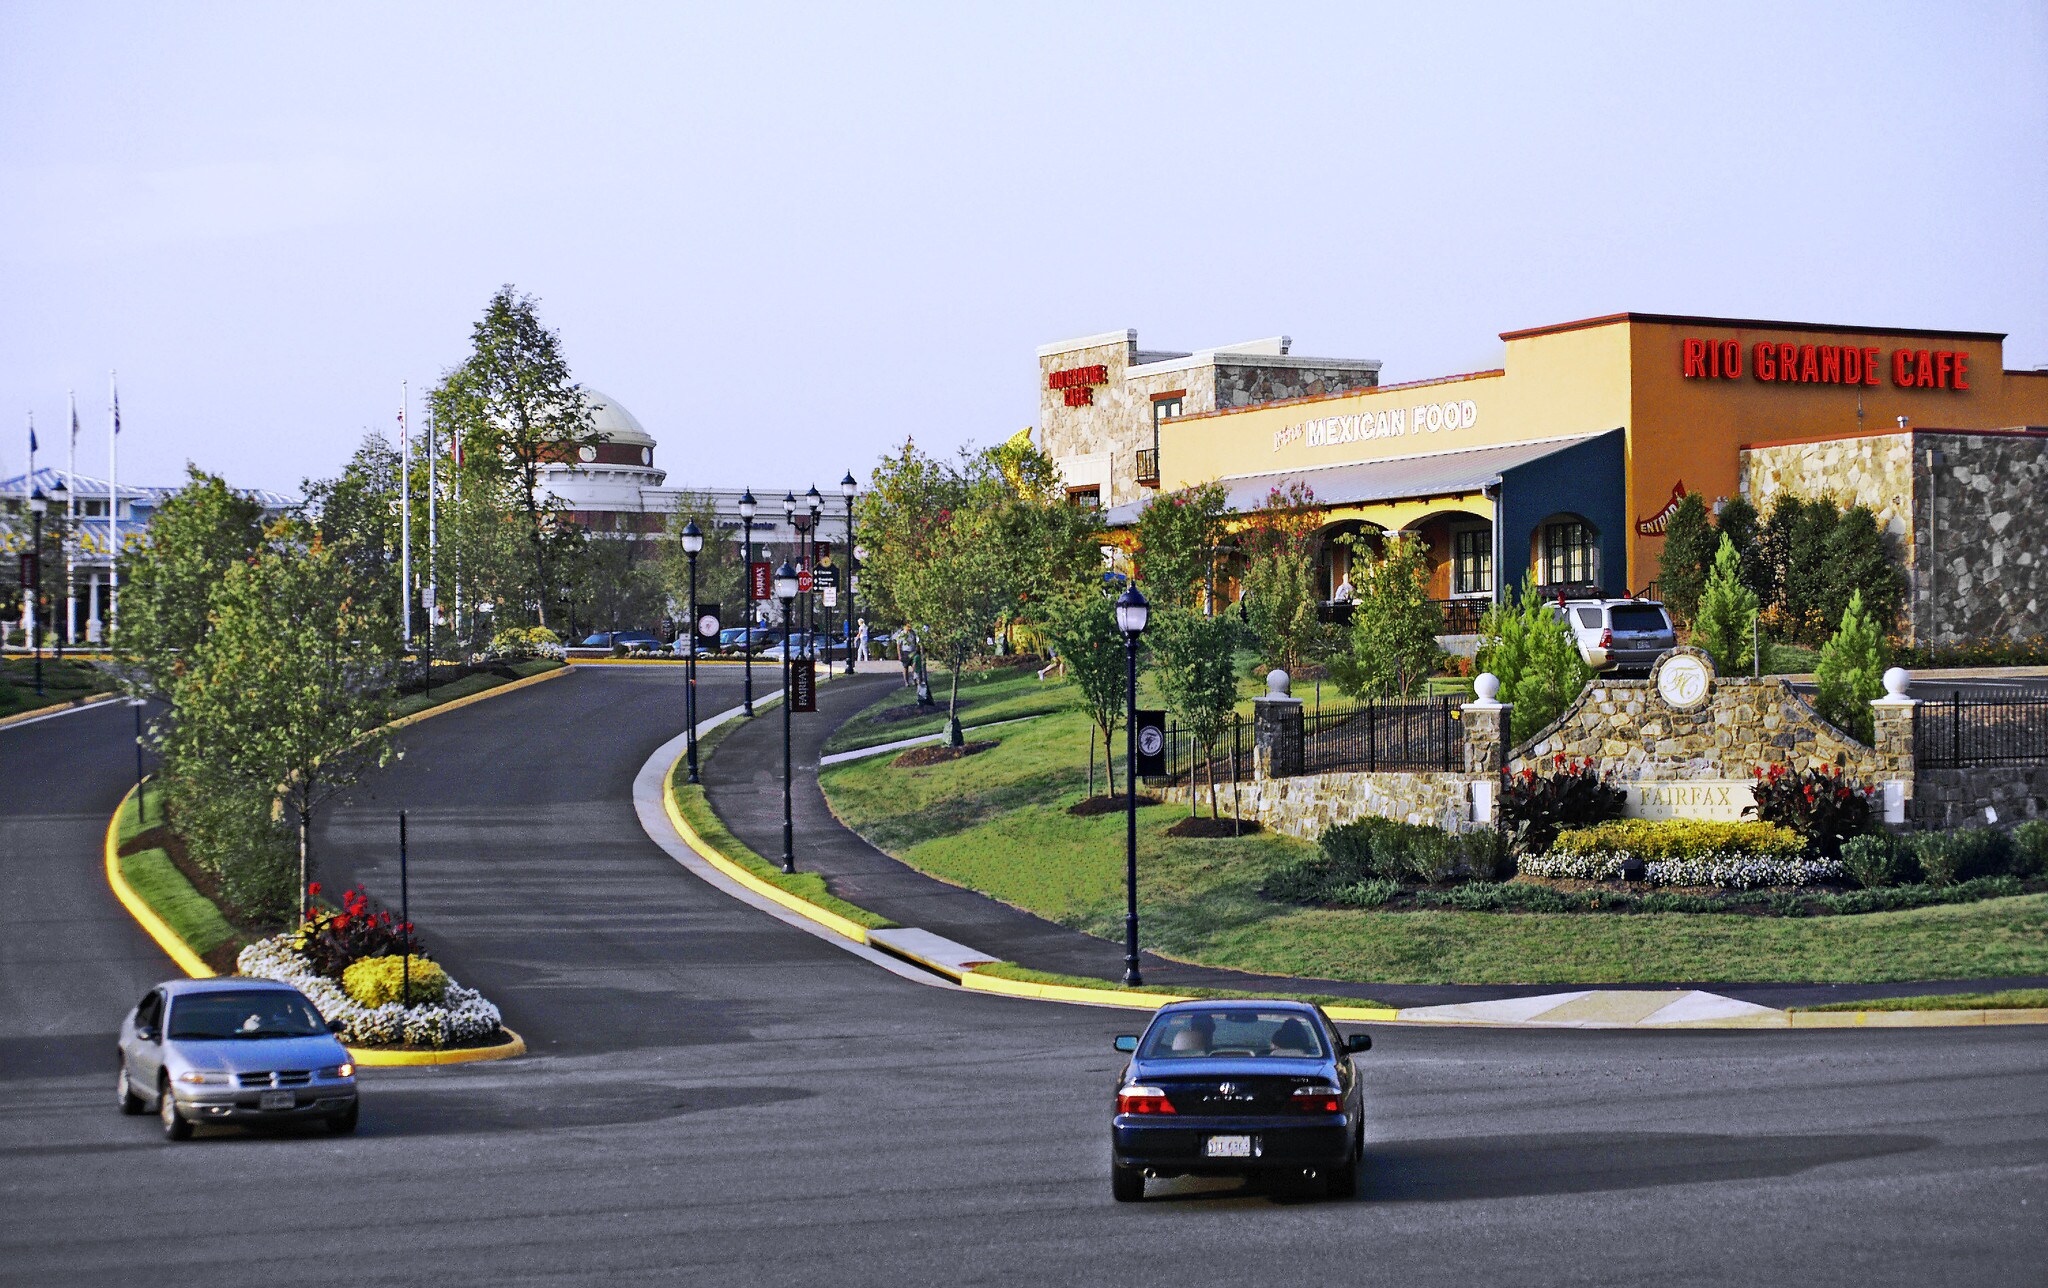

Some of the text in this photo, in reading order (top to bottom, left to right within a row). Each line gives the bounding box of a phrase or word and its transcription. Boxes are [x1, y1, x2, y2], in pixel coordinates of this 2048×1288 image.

[1683, 338, 1969, 390] RIO GRANDE CAFE
[1305, 409, 1406, 448] MEXICAN
[1412, 400, 1478, 435] FOOD
[755, 566, 766, 597] FAIRFAX
[799, 577, 813, 587] TOP
[798, 666, 807, 706] FAIRFAX
[1640, 787, 1732, 806] FAIRFAX
